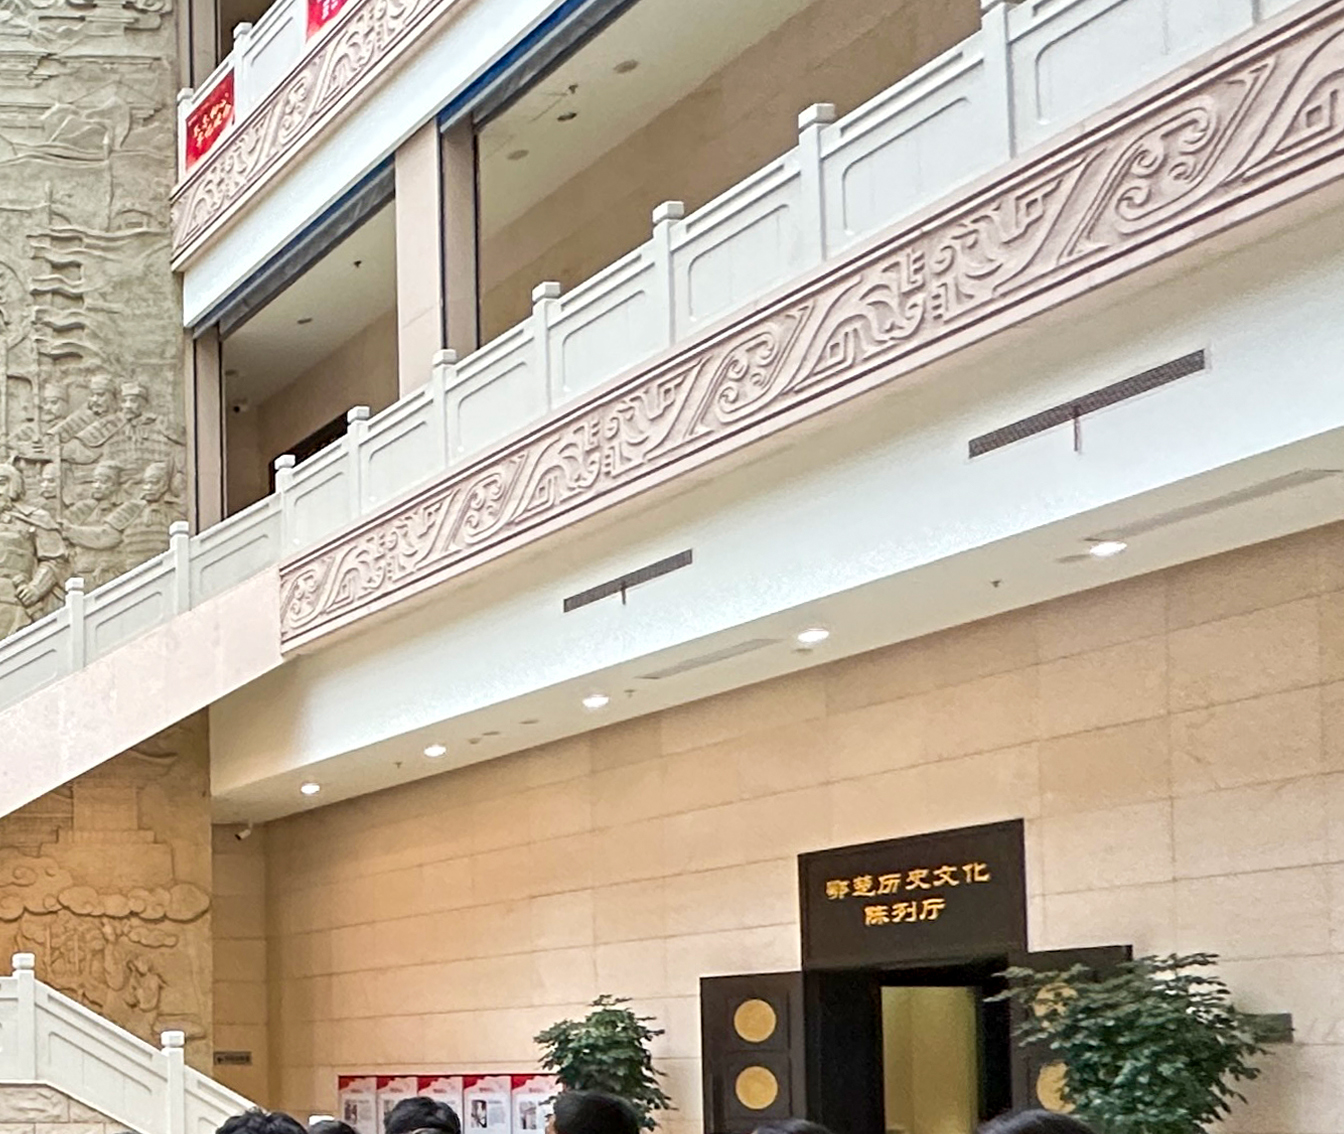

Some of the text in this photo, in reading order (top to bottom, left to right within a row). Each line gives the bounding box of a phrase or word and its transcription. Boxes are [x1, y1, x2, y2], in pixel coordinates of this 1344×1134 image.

[826, 862, 992, 900] 鄂楚历史文化
[864, 898, 947, 926] 陈列厅
